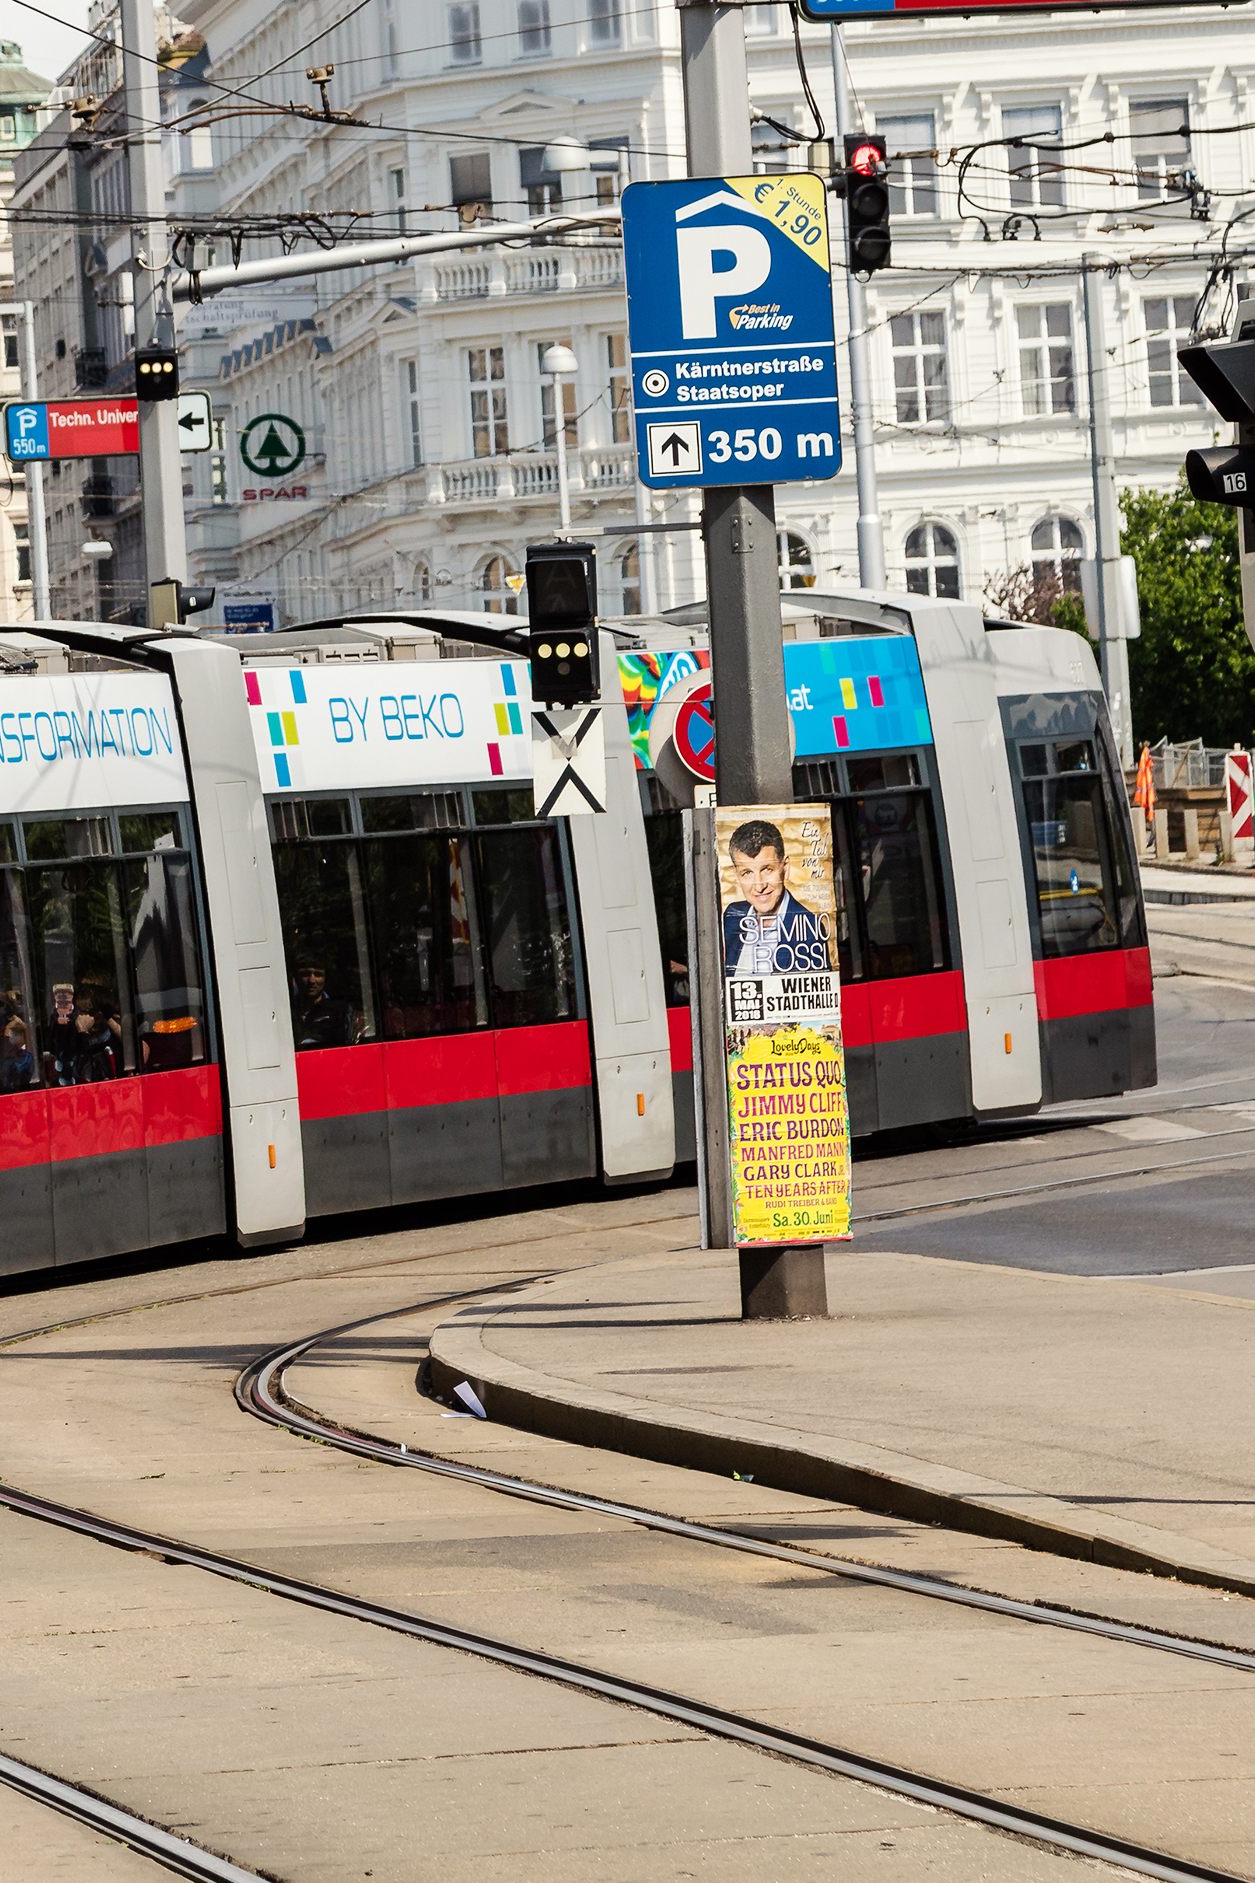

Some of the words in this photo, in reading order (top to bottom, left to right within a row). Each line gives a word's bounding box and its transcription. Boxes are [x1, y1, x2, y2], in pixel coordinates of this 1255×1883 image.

[786, 186, 822, 220] Stunde
[754, 182, 775, 204] €
[774, 199, 822, 246] 1,90
[676, 224, 772, 340] P
[748, 303, 771, 315] Best
[770, 302, 781, 313] in
[736, 312, 794, 330] Parking
[675, 355, 824, 380] Kärntnerstraße
[676, 381, 785, 402] Staatsoper
[49, 410, 95, 428] Techn.
[97, 408, 139, 425] Univer
[707, 427, 783, 463] 350
[797, 431, 834, 458] m
[1226, 473, 1246, 491] 16
[242, 485, 308, 501] SPAR
[786, 683, 814, 712] .at
[328, 697, 369, 743] BY
[380, 693, 464, 742] BEKO
[738, 912, 831, 945] SEMINO
[753, 942, 828, 973] ROSSI
[730, 981, 762, 1000] 13.
[781, 976, 832, 994] WIENER
[734, 999, 762, 1011] MAI
[767, 993, 833, 1012] STADTHALLE
[736, 1061, 812, 1091] STATUS
[815, 1060, 841, 1088] QUO
[737, 1094, 806, 1118] JIMMY
[809, 1091, 841, 1114] CLIFF
[740, 1121, 783, 1142] ERIC
[786, 1117, 844, 1140] BURDON
[741, 1143, 814, 1162] MANFRED
[816, 1141, 844, 1158] MANN
[744, 1164, 790, 1181] GARY
[794, 1160, 836, 1178] CLARK
[745, 1184, 773, 1199] TEN
[776, 1181, 817, 1198] YEARS
[818, 1179, 846, 1195] AFTER
[765, 1201, 786, 1209] RUDI
[788, 1199, 820, 1208] TREIBER
[773, 1212, 792, 1228] Sa.
[793, 1211, 812, 1226] 30.
[813, 1209, 834, 1225] Juni
